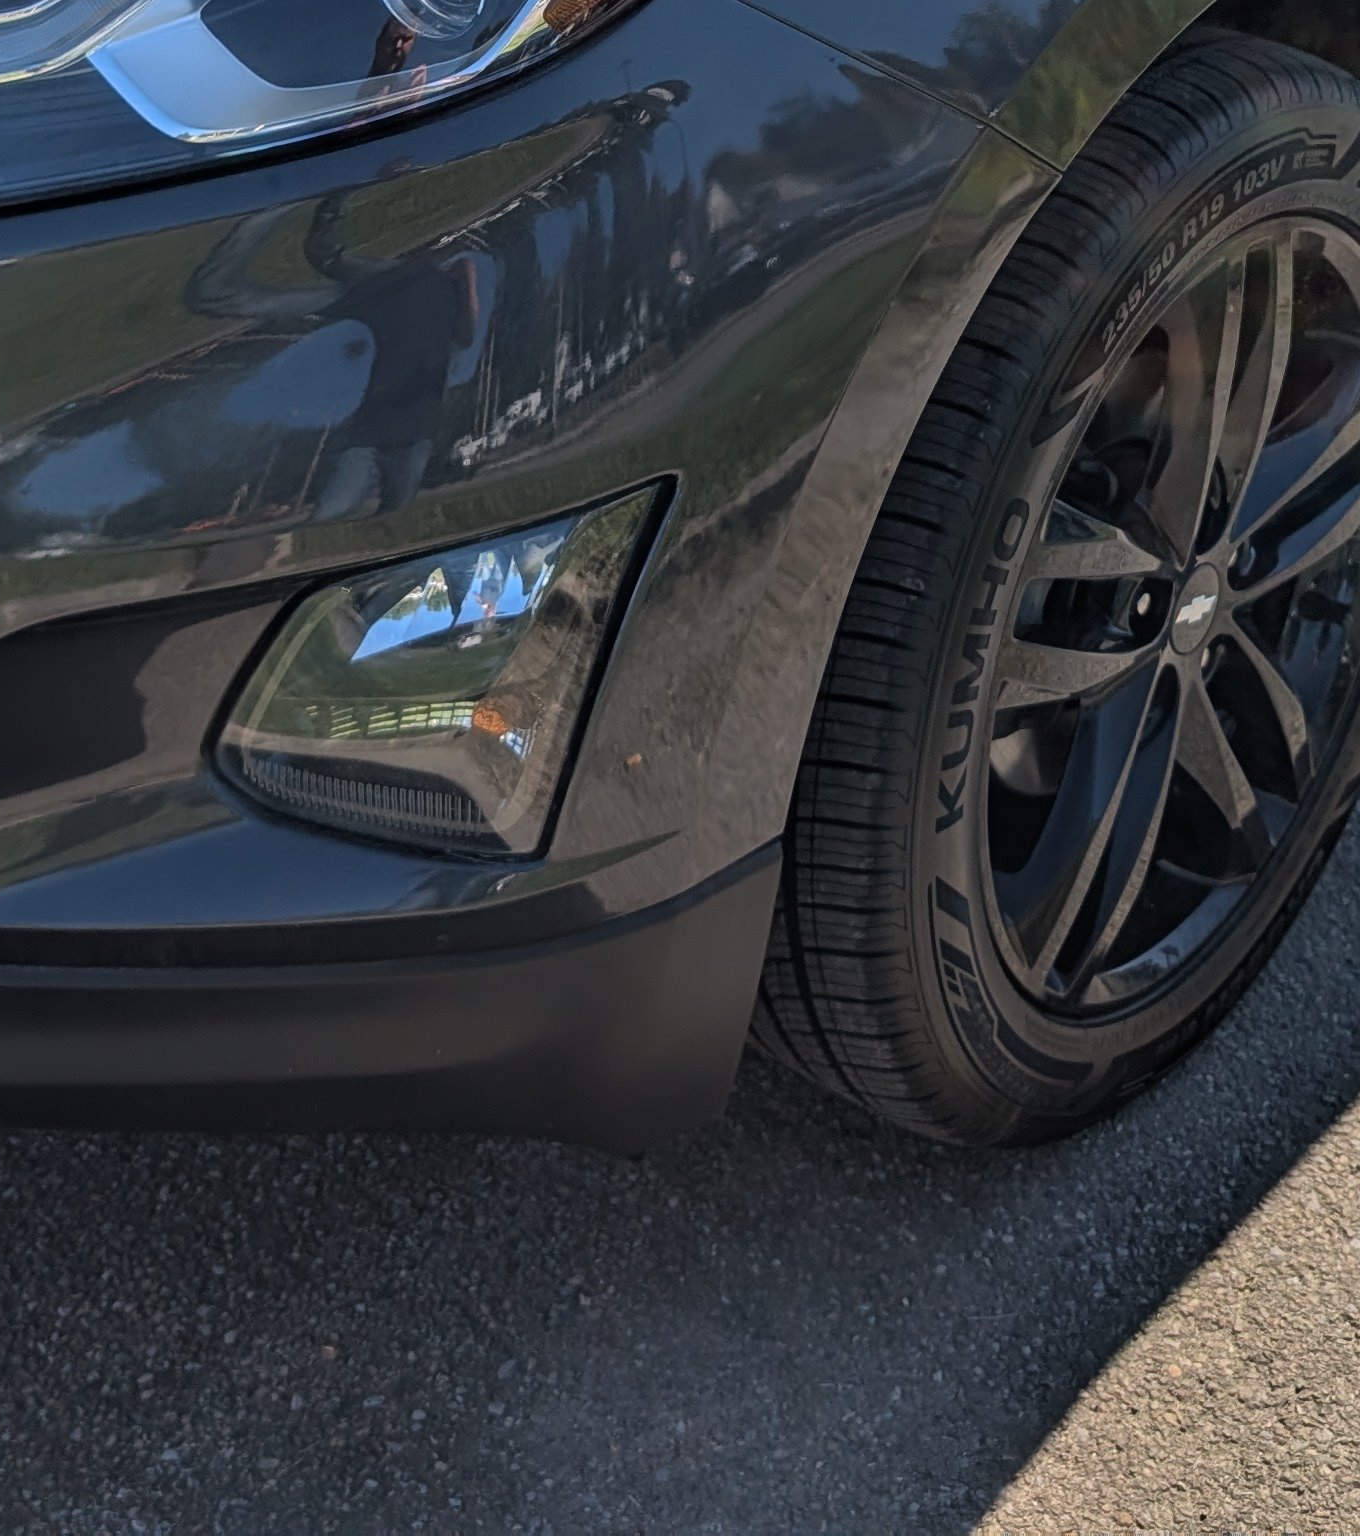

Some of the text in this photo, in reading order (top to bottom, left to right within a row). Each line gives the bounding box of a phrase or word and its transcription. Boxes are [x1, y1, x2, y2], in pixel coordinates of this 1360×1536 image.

[1101, 241, 1176, 353] 235/50
[1182, 194, 1224, 248] R19
[1232, 156, 1285, 202] 103V
[935, 498, 1030, 834] KUMHO
